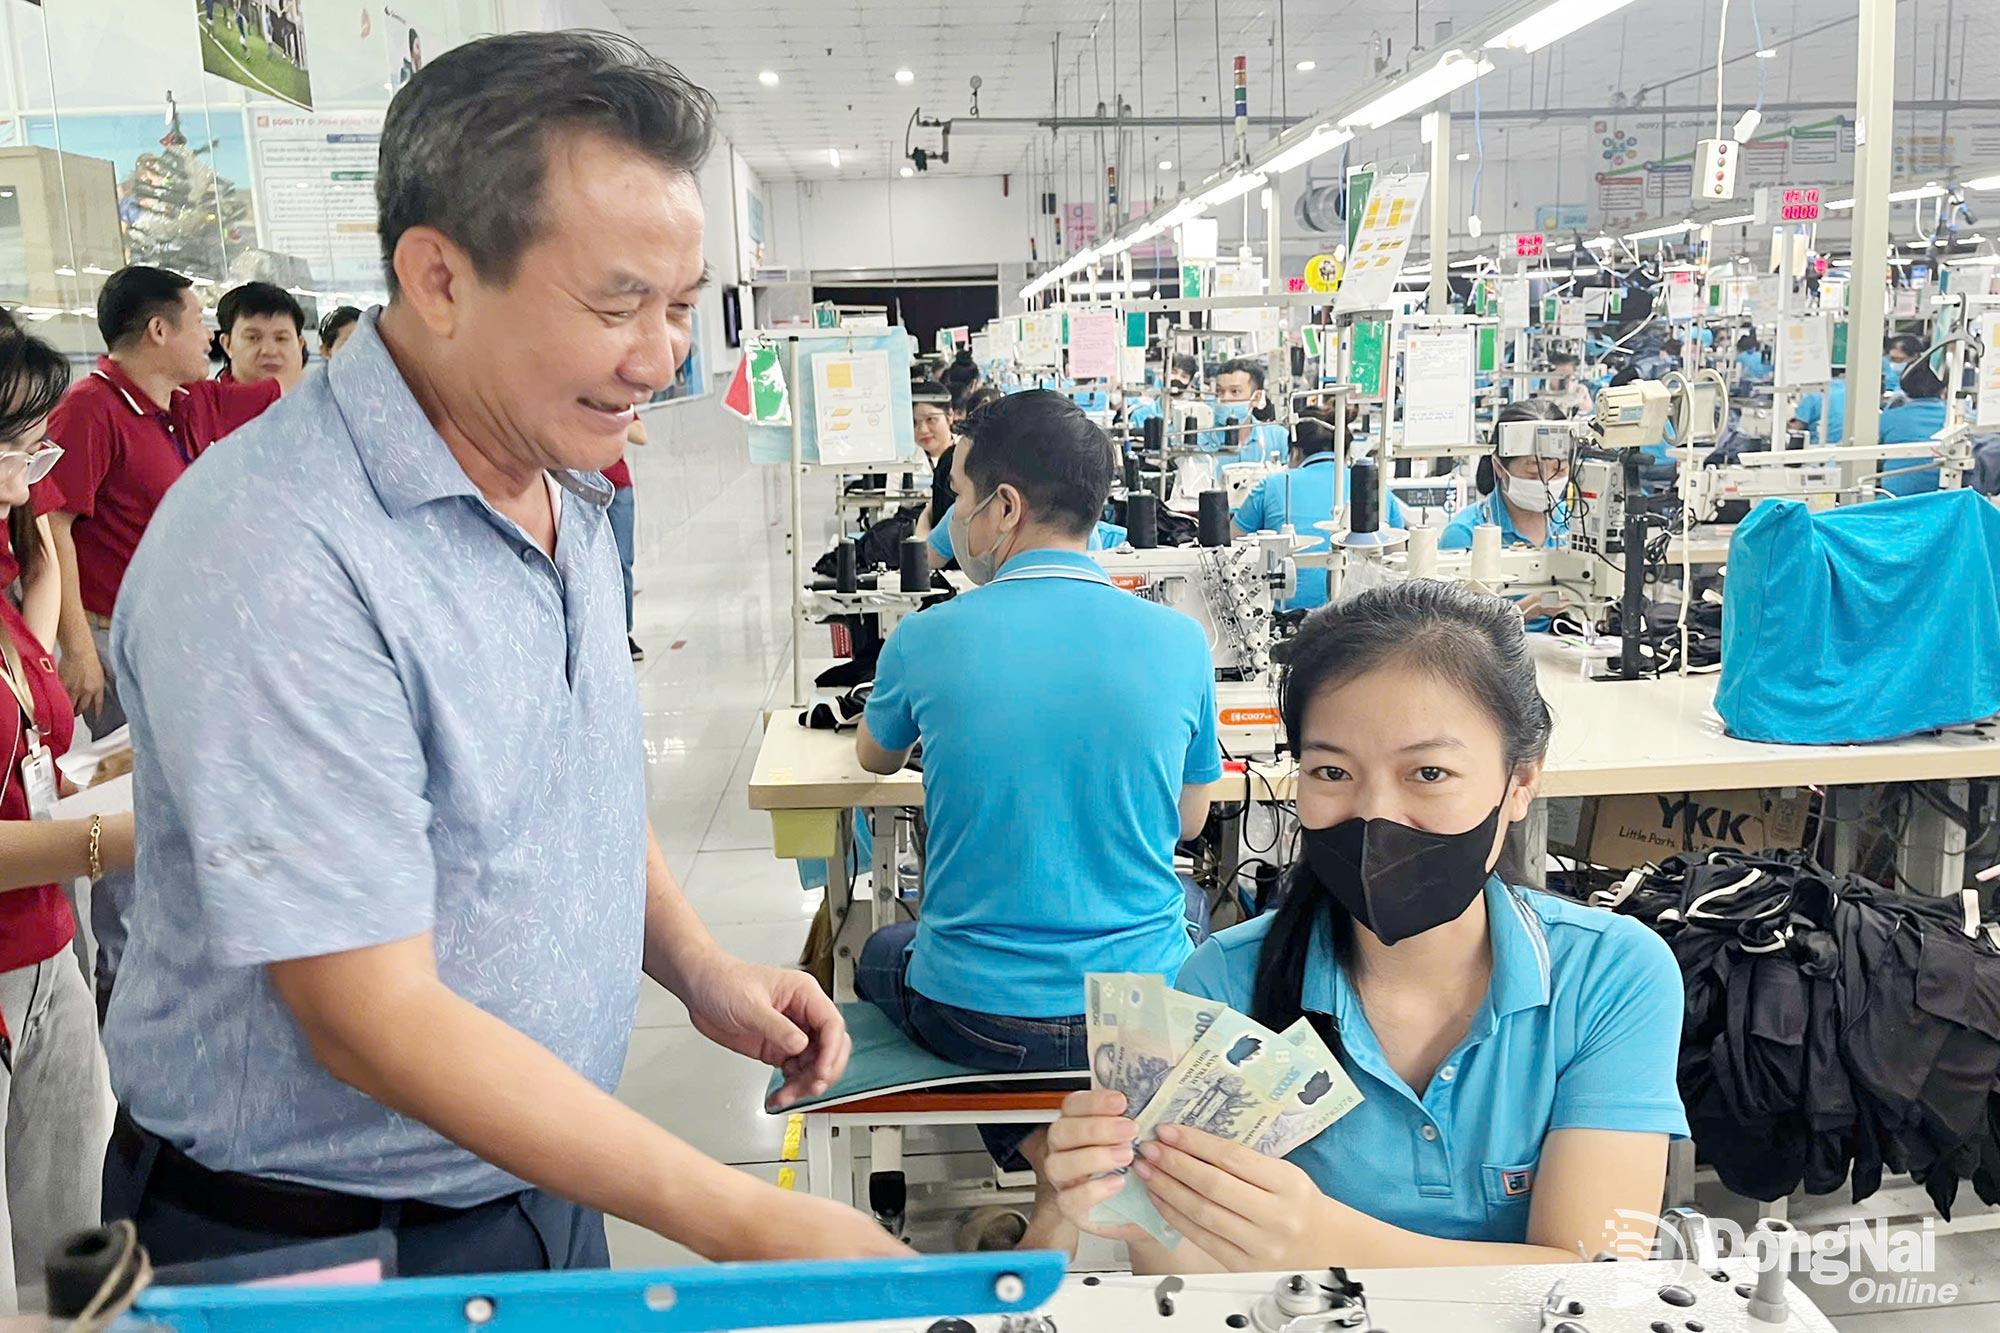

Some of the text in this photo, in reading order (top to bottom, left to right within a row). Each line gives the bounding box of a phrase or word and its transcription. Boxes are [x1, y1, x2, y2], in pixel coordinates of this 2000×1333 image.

[1619, 826, 1647, 843] Little
[1649, 832, 1676, 848] Parts
[1657, 795, 1750, 845] YKK
